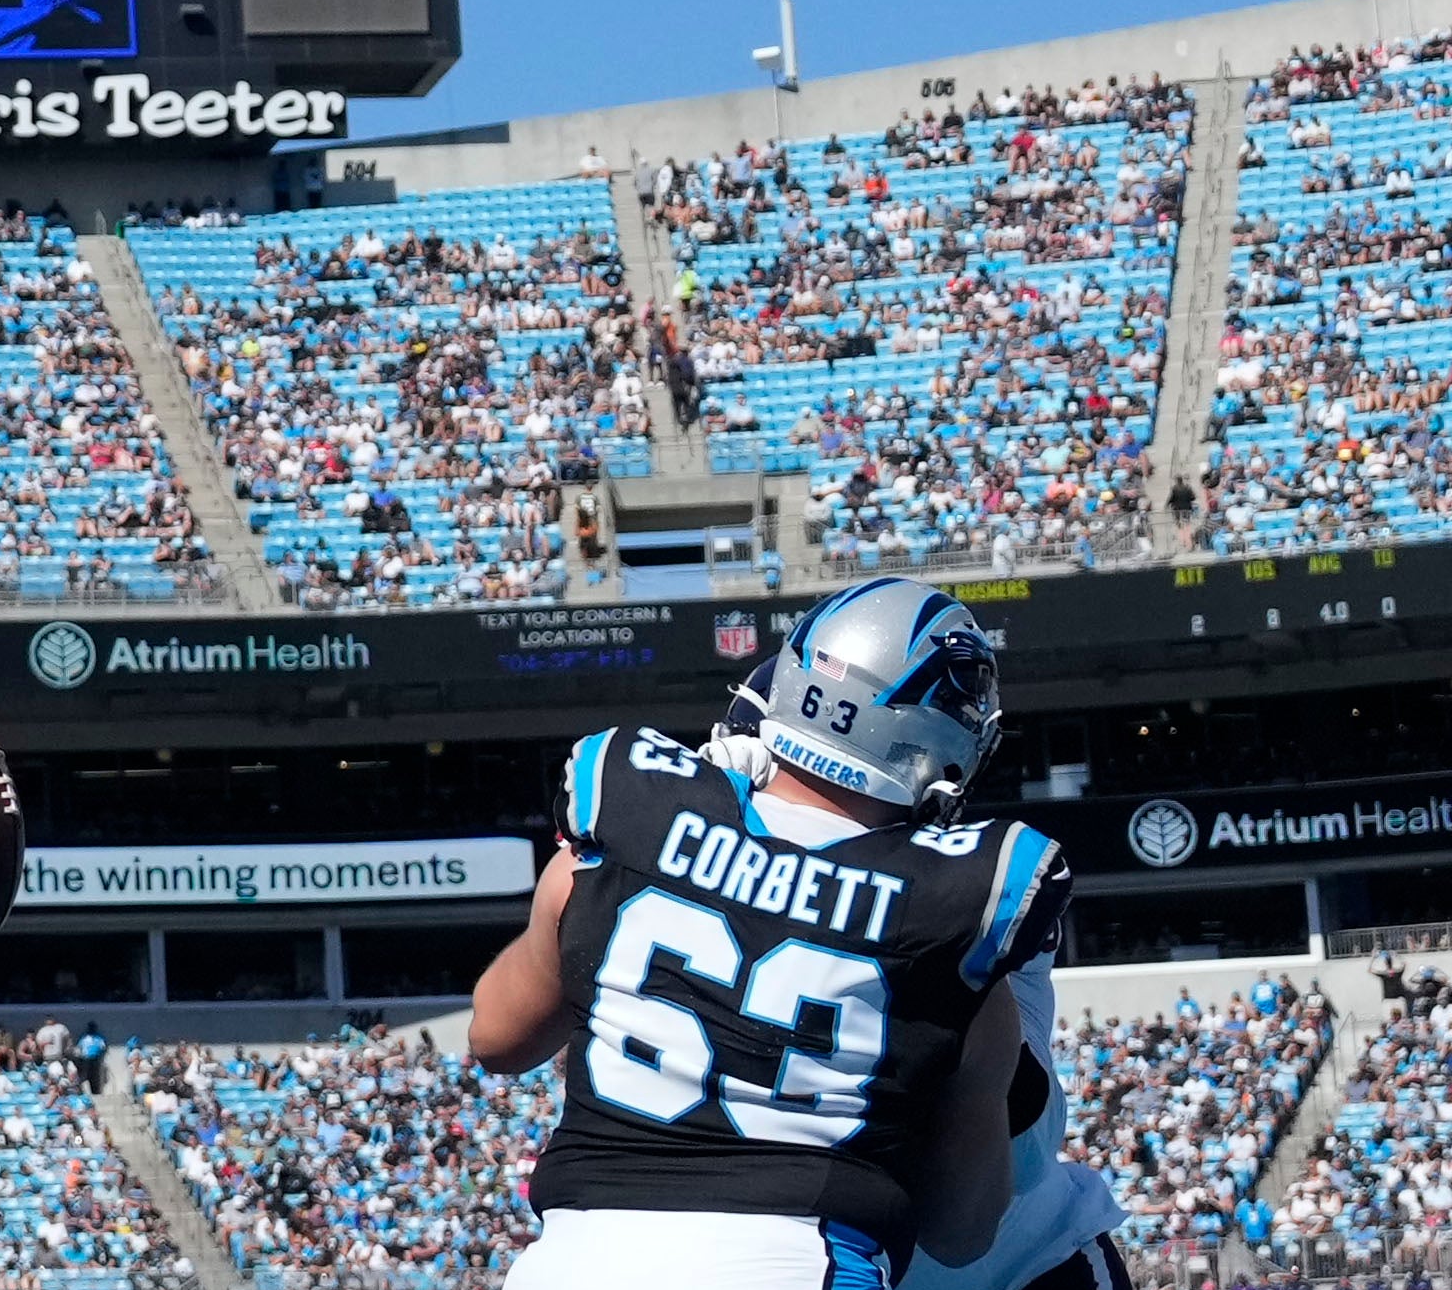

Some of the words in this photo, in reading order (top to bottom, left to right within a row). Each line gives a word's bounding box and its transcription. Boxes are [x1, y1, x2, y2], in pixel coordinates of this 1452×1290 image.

[92, 71, 346, 138] Teeter
[478, 612, 517, 629] TEXT
[523, 611, 570, 628] YOUR
[572, 606, 658, 626] CONCERN
[519, 628, 606, 648] LOCATION
[609, 626, 635, 645] TO
[106, 637, 242, 674] Atrium
[248, 633, 370, 672] Health
[800, 684, 859, 735] 63
[773, 733, 870, 793] PANTHERS
[1208, 808, 1350, 850] Atrium
[1354, 795, 1452, 839] Healt
[23, 859, 84, 894] the
[98, 854, 258, 900] winning
[270, 851, 467, 890] moments
[657, 810, 905, 943] CORBETT
[584, 884, 893, 1149] 63
